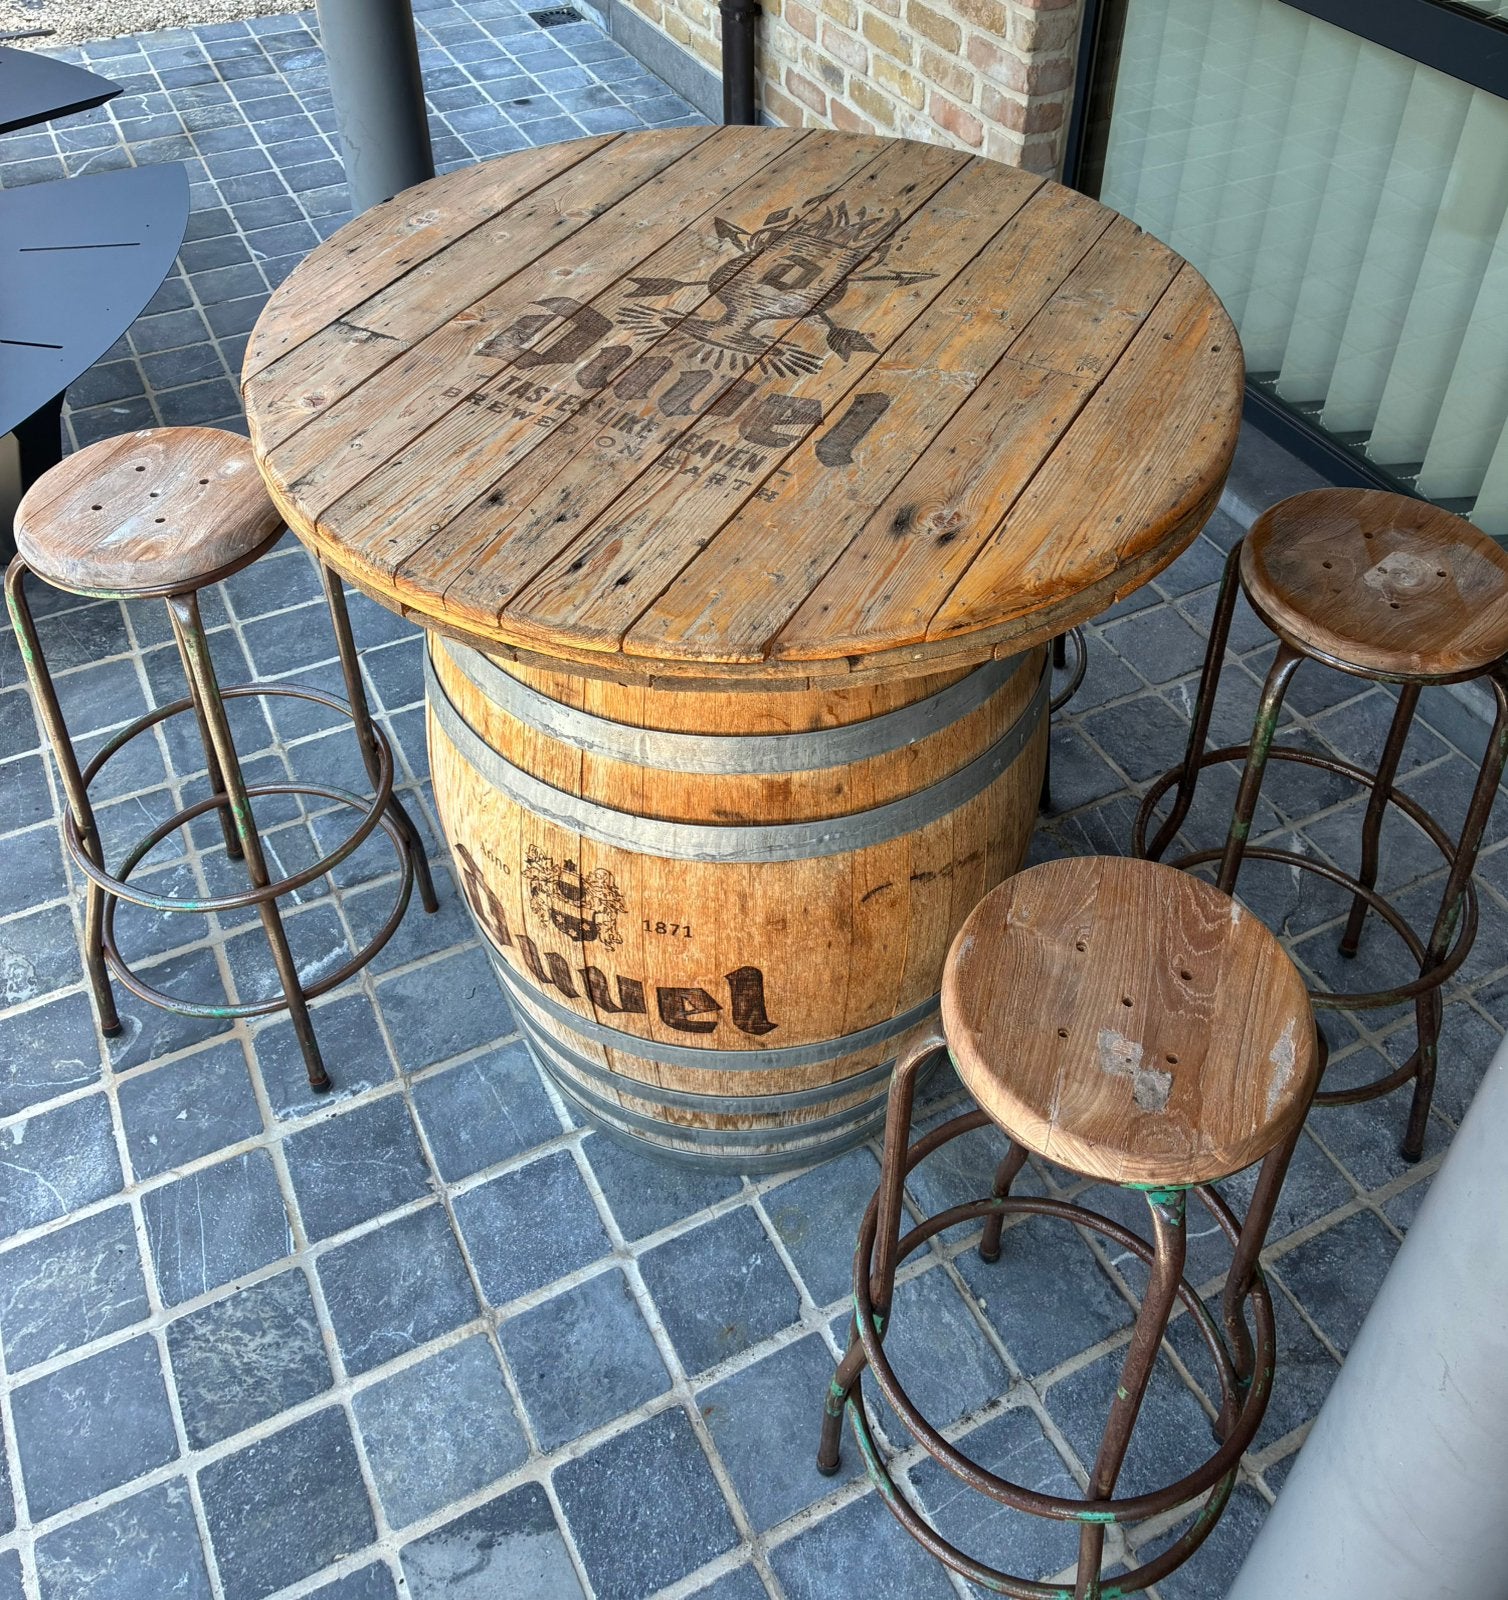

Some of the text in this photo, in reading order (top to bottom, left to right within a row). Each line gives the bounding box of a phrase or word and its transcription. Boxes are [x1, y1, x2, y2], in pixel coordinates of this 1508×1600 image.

[474, 296, 890, 468] Duvel
[497, 375, 768, 474] TASTES LIKE HEAVEN
[442, 386, 780, 504] BREWED ON EARTH
[480, 841, 693, 939] Anno 1871
